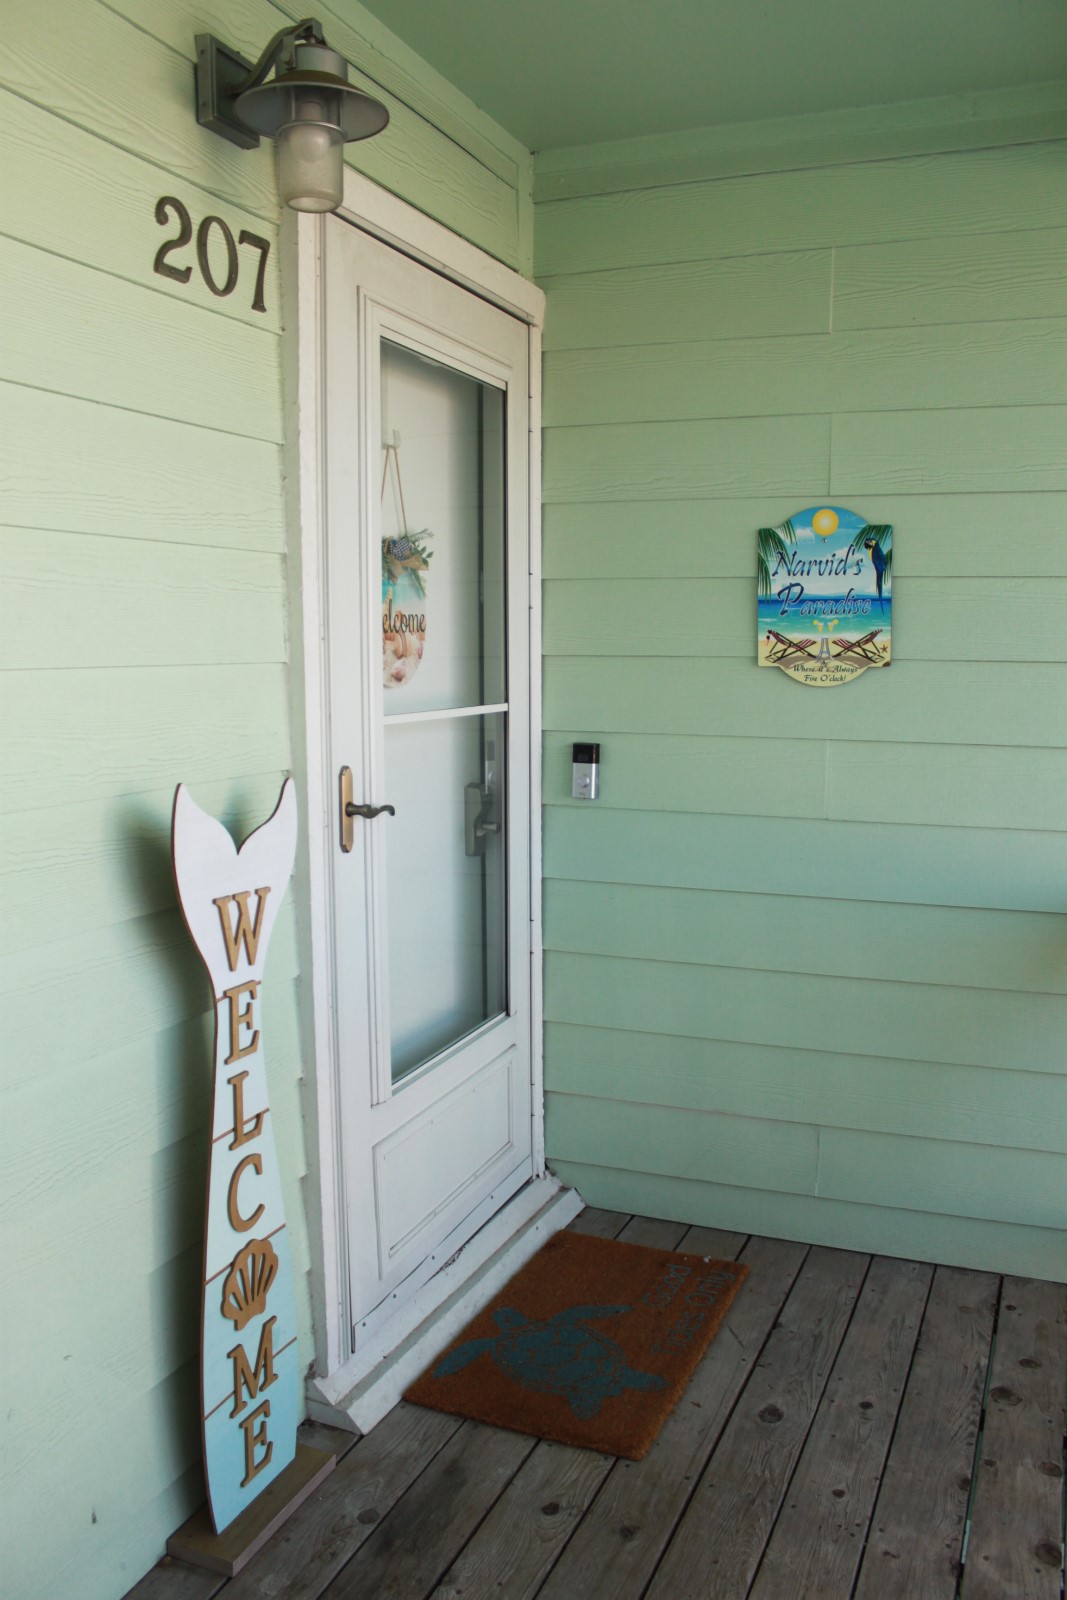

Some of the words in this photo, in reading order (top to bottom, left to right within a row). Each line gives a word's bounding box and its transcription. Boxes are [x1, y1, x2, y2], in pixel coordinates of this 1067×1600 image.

[153, 195, 271, 314] 207
[772, 544, 863, 577] Narvid's
[382, 598, 427, 634] elcome
[777, 582, 872, 617] Paradise
[793, 664, 816, 673] Where
[832, 664, 858, 675] Always
[803, 674, 818, 682] Five
[641, 1263, 693, 1308] Good
[684, 1270, 736, 1308] Only
